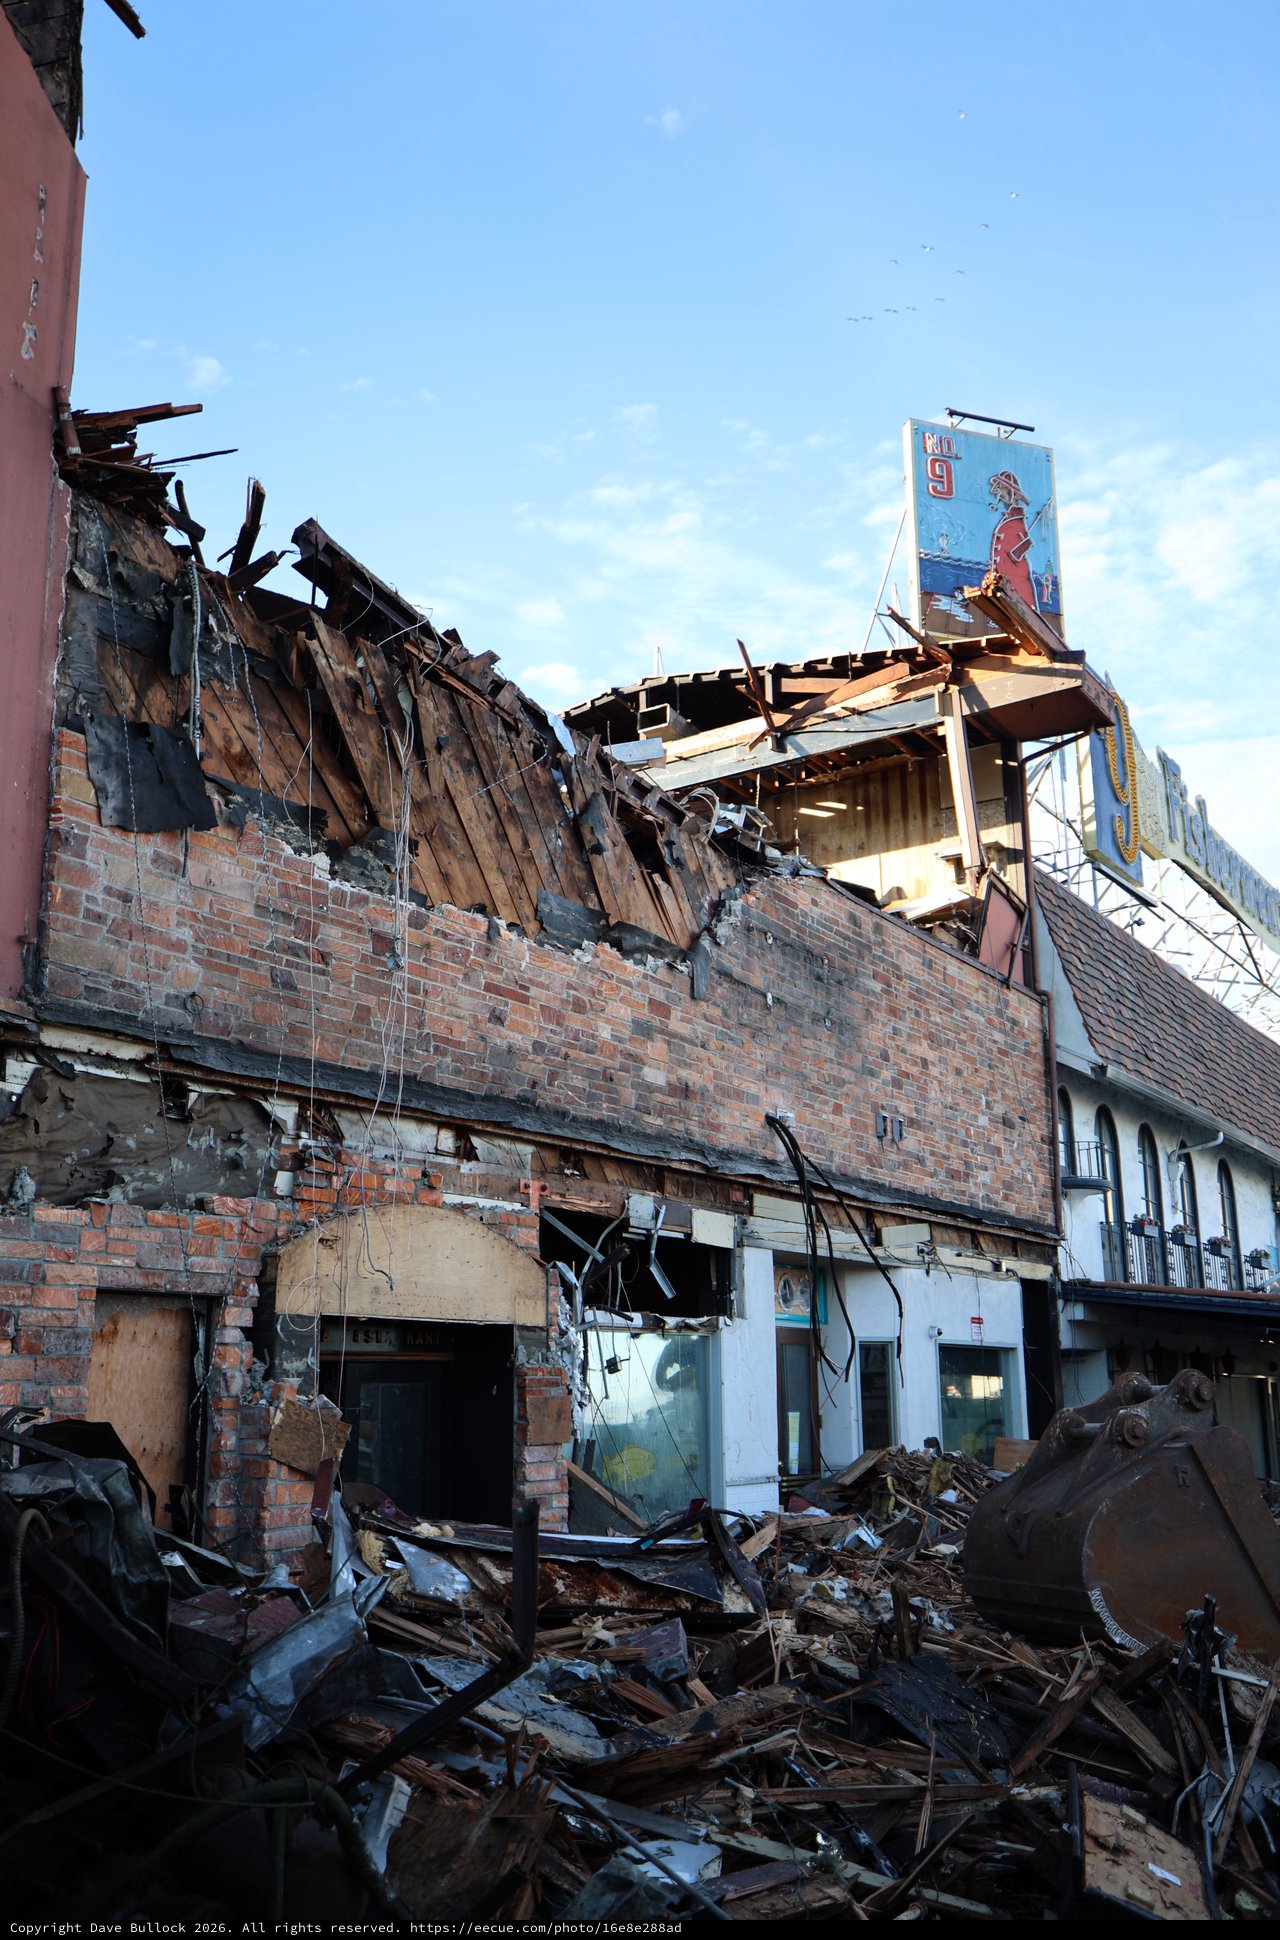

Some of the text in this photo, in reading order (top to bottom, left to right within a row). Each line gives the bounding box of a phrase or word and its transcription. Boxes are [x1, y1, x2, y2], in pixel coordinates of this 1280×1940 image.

[923, 431, 961, 460] NO.
[926, 455, 955, 500] 9
[1105, 692, 1140, 865] 9
